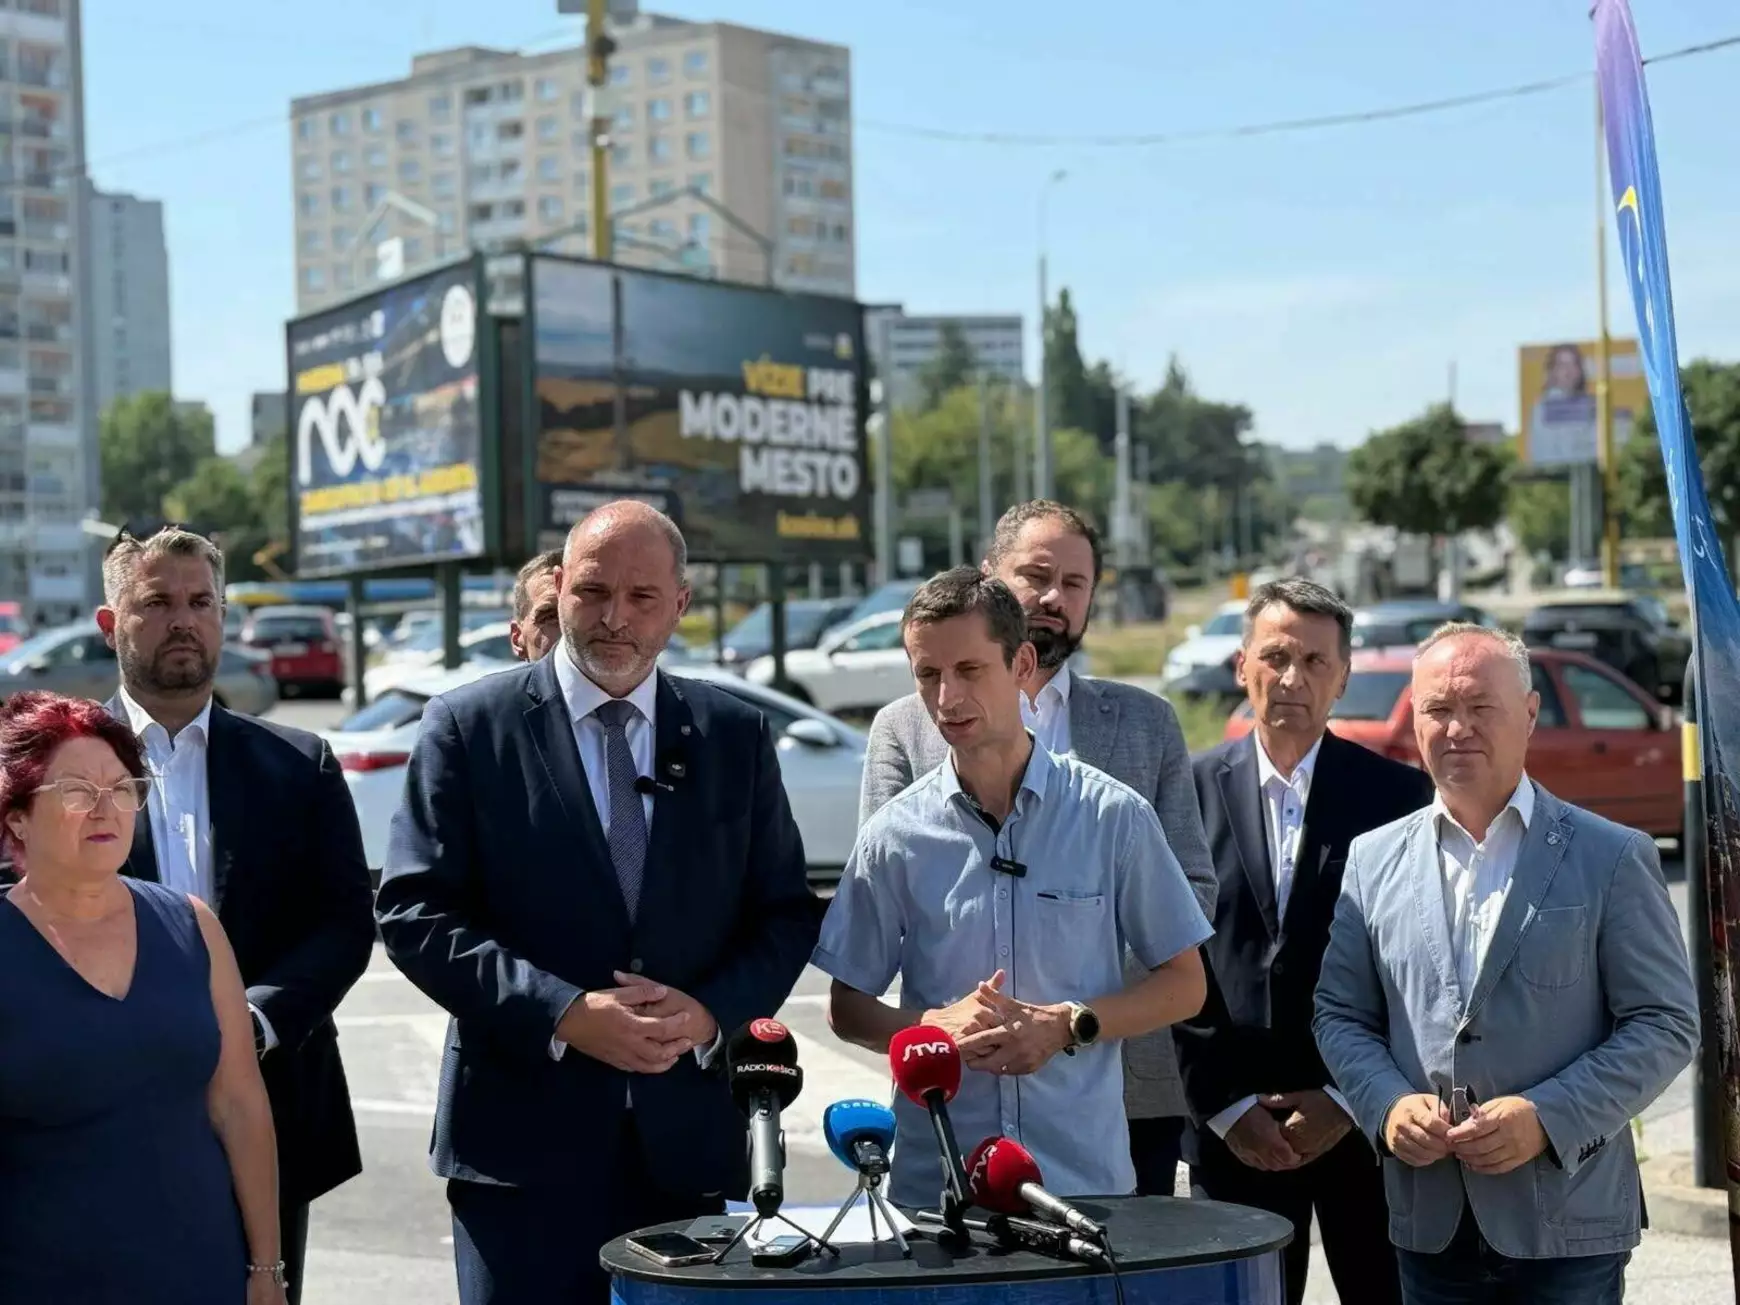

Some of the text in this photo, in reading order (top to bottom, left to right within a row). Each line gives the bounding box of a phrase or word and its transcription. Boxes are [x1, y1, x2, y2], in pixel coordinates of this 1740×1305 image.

[740, 445, 860, 500] MESTO
[902, 1041, 950, 1062] STVR
[736, 1063, 766, 1074] RÁDIO
